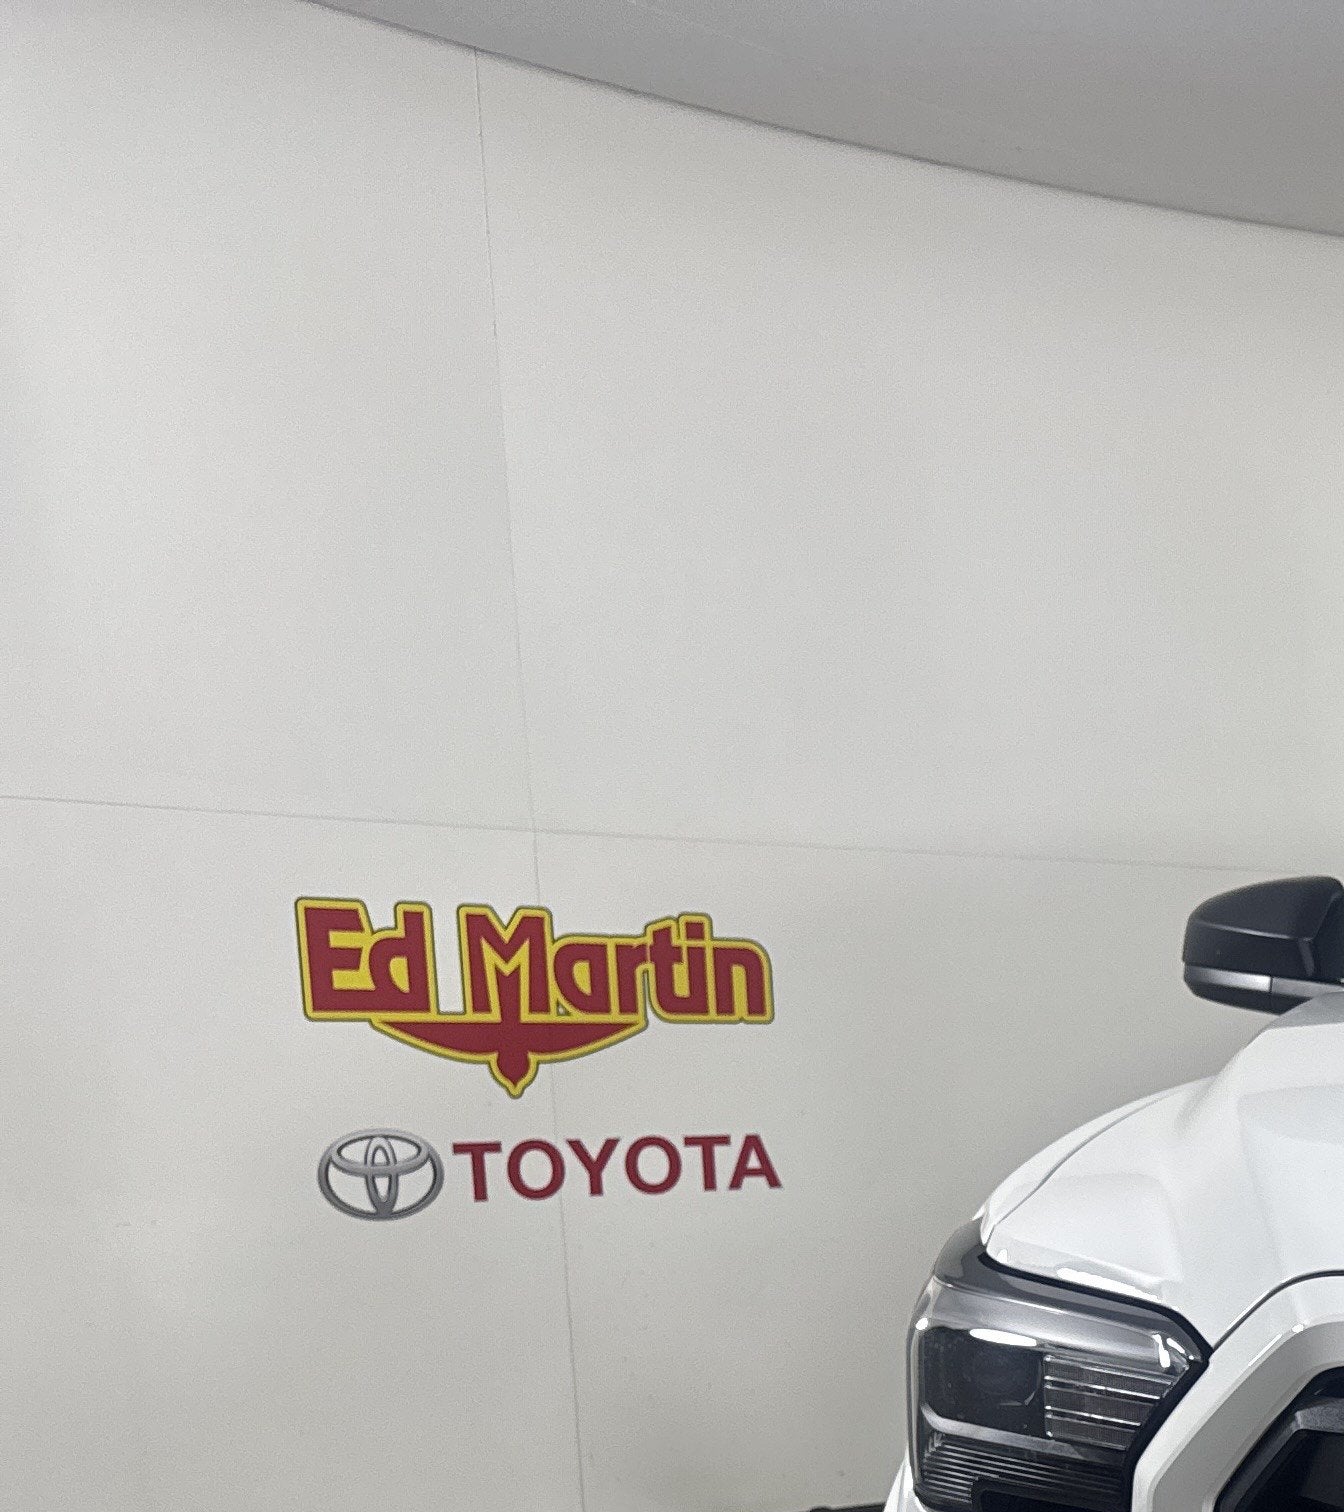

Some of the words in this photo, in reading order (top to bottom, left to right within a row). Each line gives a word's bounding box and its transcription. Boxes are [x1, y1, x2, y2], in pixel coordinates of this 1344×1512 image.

[300, 902, 431, 1016] Ed
[462, 908, 770, 1020] Martin
[453, 1134, 782, 1202] TOYOTA
